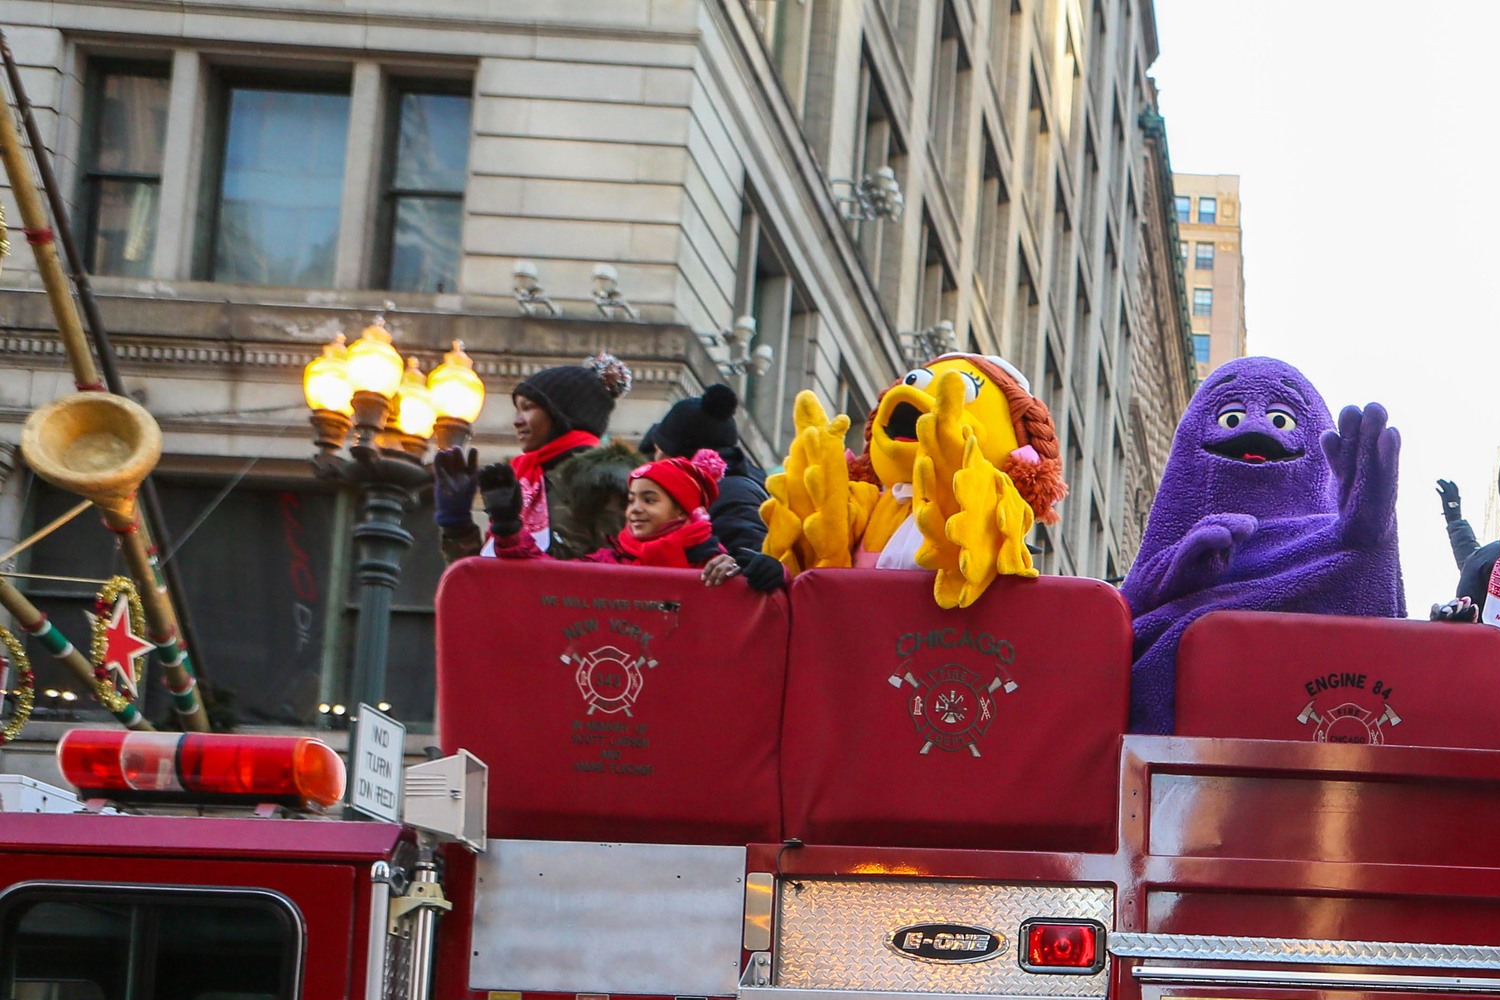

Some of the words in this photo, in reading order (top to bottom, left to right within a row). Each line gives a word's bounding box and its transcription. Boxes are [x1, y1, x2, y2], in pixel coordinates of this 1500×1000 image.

[562, 597, 589, 608] WILL
[592, 598, 630, 610] NEVER
[561, 618, 598, 641] NEW
[609, 618, 654, 649] YORK
[896, 627, 1016, 664] CHICAGO
[596, 673, 621, 688] 343
[938, 669, 968, 681] FIRE
[1304, 673, 1367, 697] ENGINE
[1372, 681, 1393, 700] 84
[1337, 707, 1361, 716] FIRE
[371, 725, 390, 748] NO
[366, 752, 392, 779] TURN
[359, 778, 373, 801] ON
[376, 786, 395, 810] RED
[902, 932, 991, 952] E-ONE
